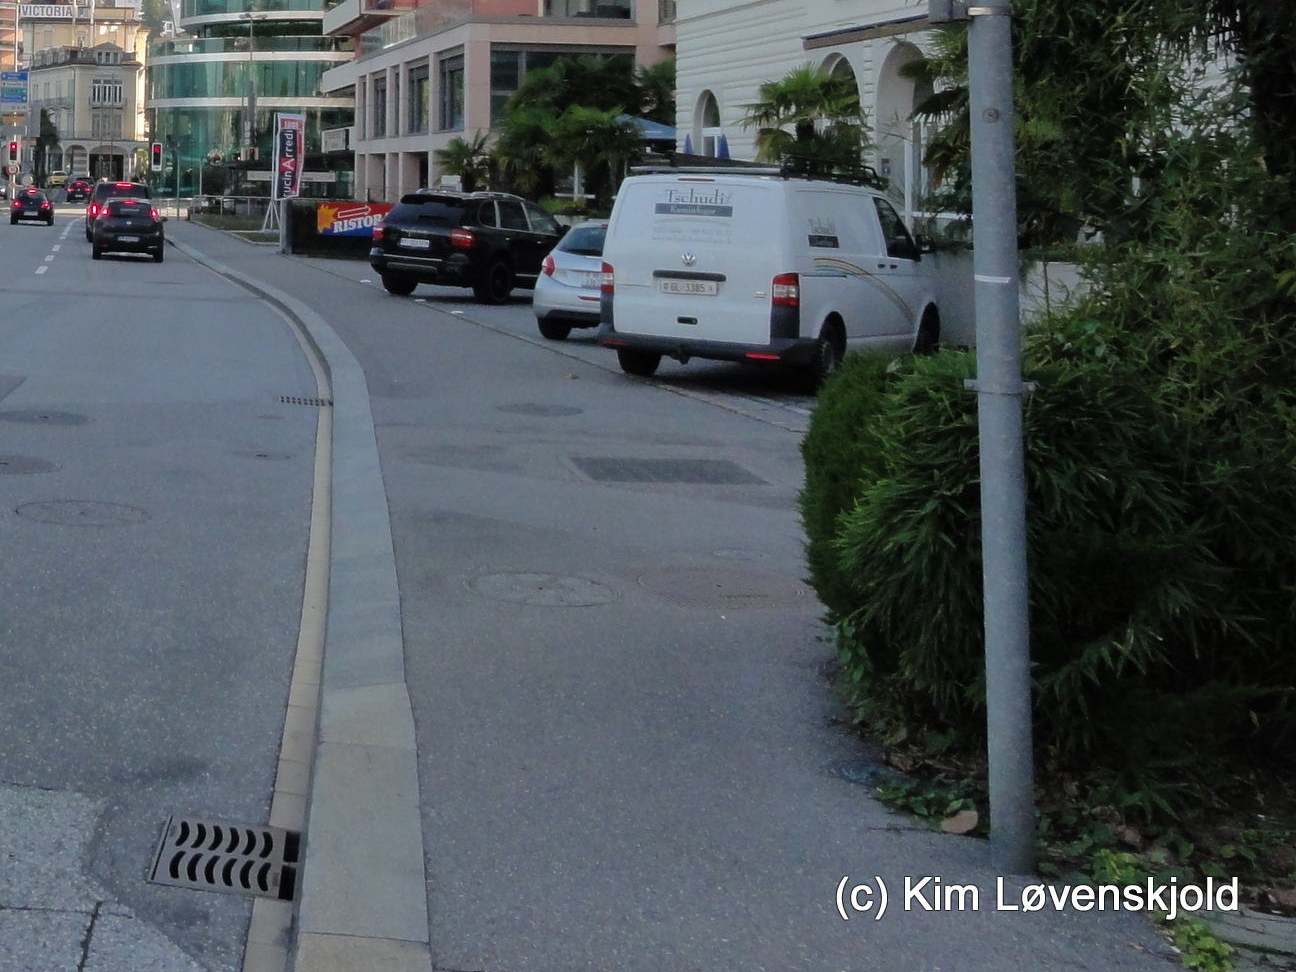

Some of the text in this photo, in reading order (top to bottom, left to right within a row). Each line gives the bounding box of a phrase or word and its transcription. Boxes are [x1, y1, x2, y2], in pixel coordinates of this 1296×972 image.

[22, 5, 72, 16] VICTORIA
[665, 188, 725, 204] Tschudi
[333, 213, 390, 233] RISTOR
[685, 283, 706, 292] 3385
